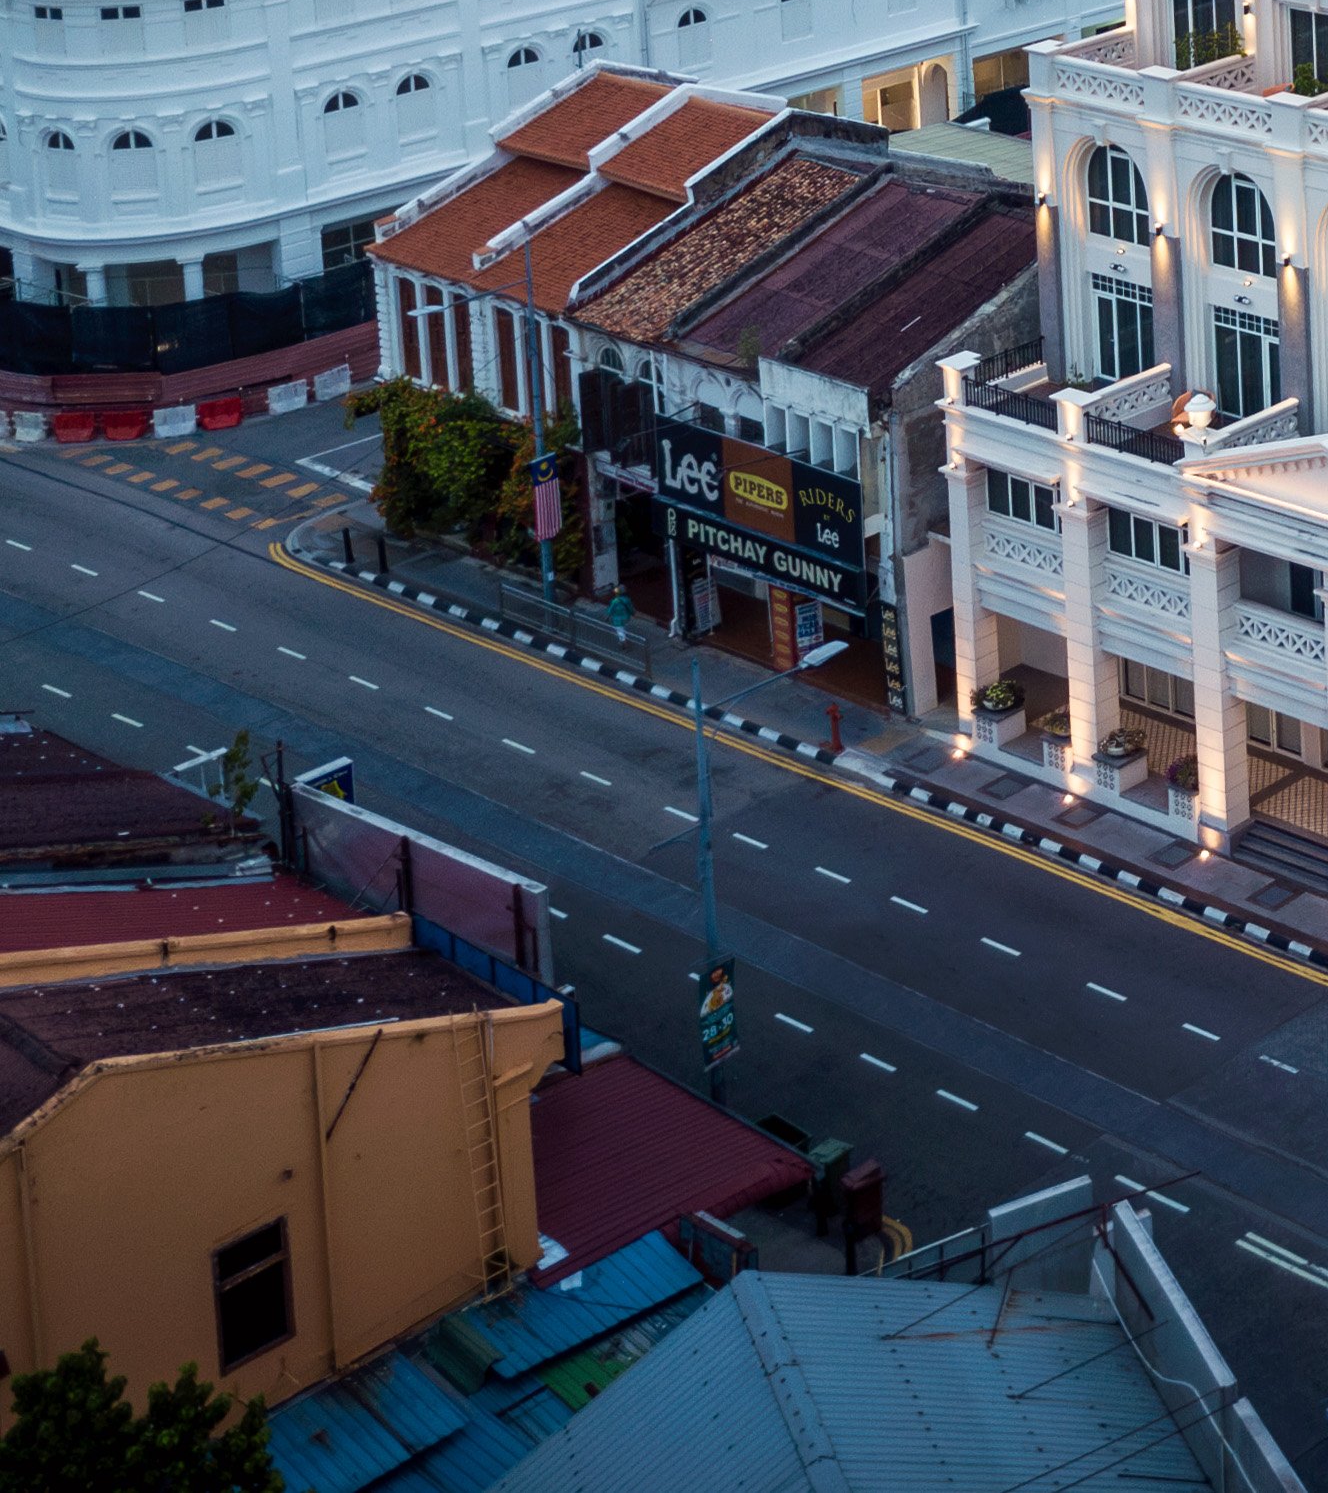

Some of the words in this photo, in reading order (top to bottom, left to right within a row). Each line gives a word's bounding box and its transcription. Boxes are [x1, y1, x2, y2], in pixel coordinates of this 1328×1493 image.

[662, 439, 719, 501] Lee
[733, 474, 785, 507] PIPERS
[799, 488, 856, 523] RIDERS
[816, 522, 840, 548] Lee
[686, 518, 768, 565] PITCHAY
[773, 550, 843, 593] GUNNY
